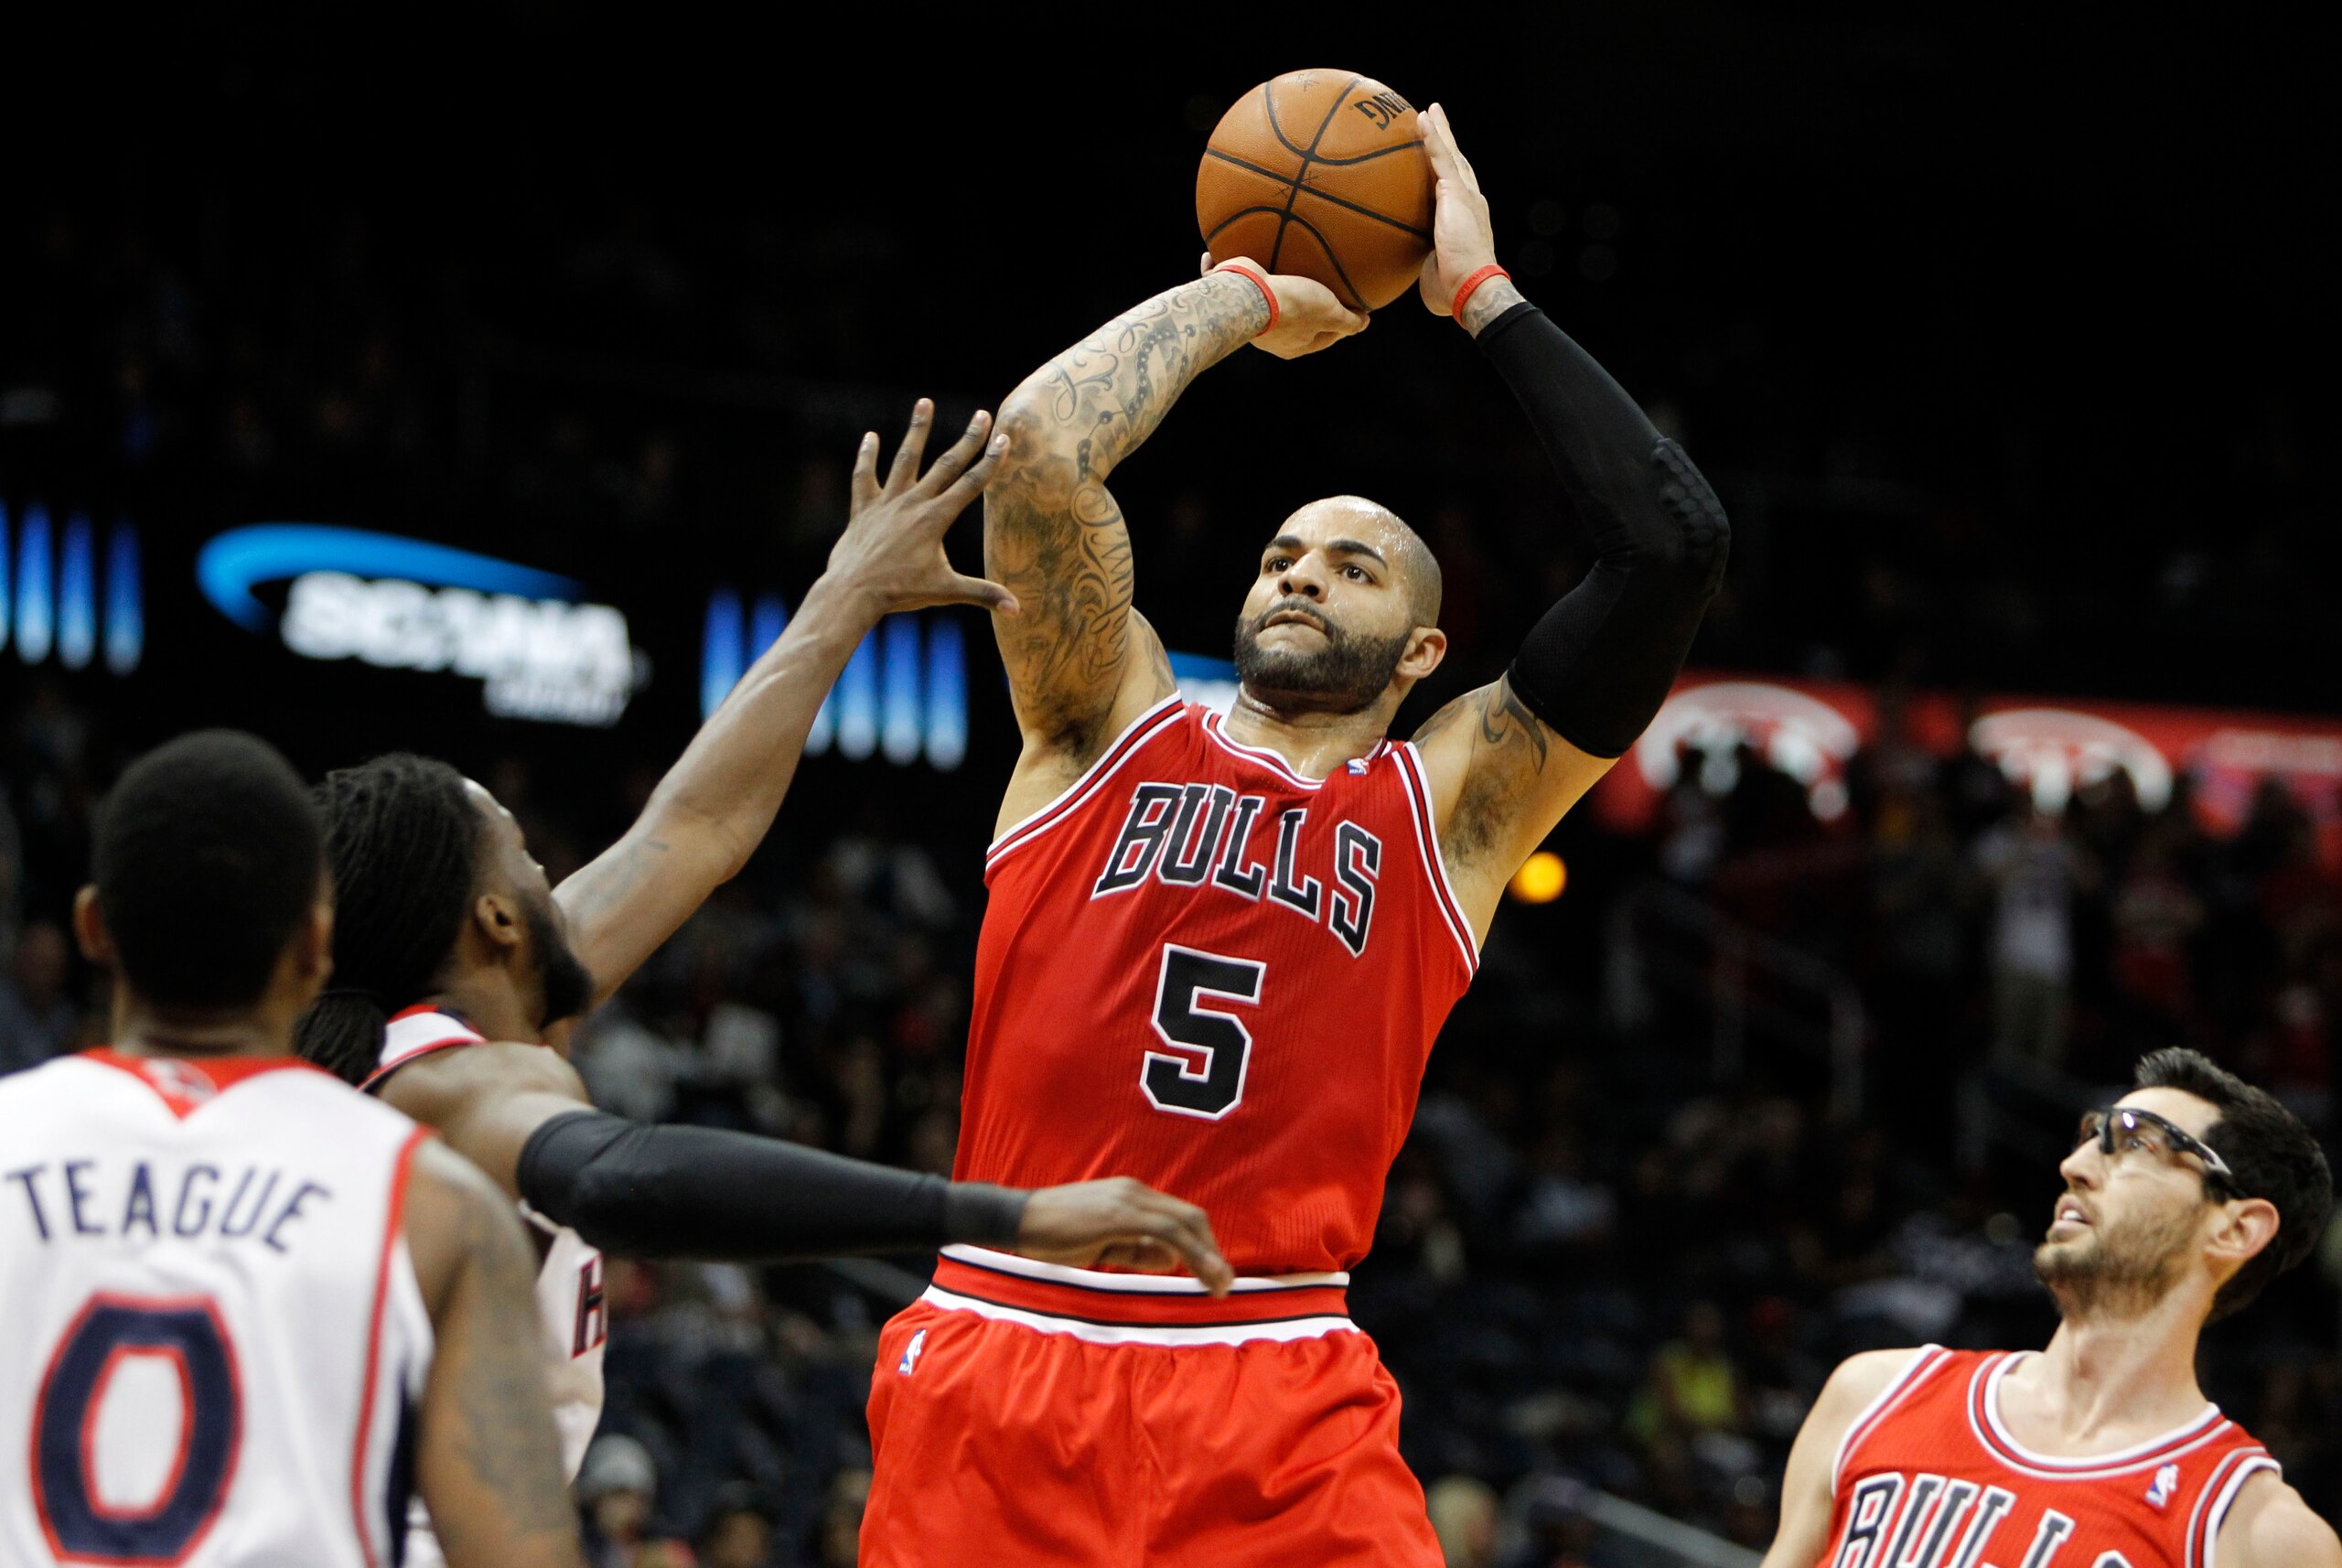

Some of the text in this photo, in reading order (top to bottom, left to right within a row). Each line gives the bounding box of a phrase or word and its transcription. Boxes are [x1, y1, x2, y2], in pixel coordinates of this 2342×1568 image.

[1090, 781, 1383, 959] BULLS
[1139, 942, 1267, 1122] 5
[3, 1159, 334, 1254] TEAGUE
[27, 1288, 246, 1568] 0
[1832, 1471, 2133, 1568] BUL
